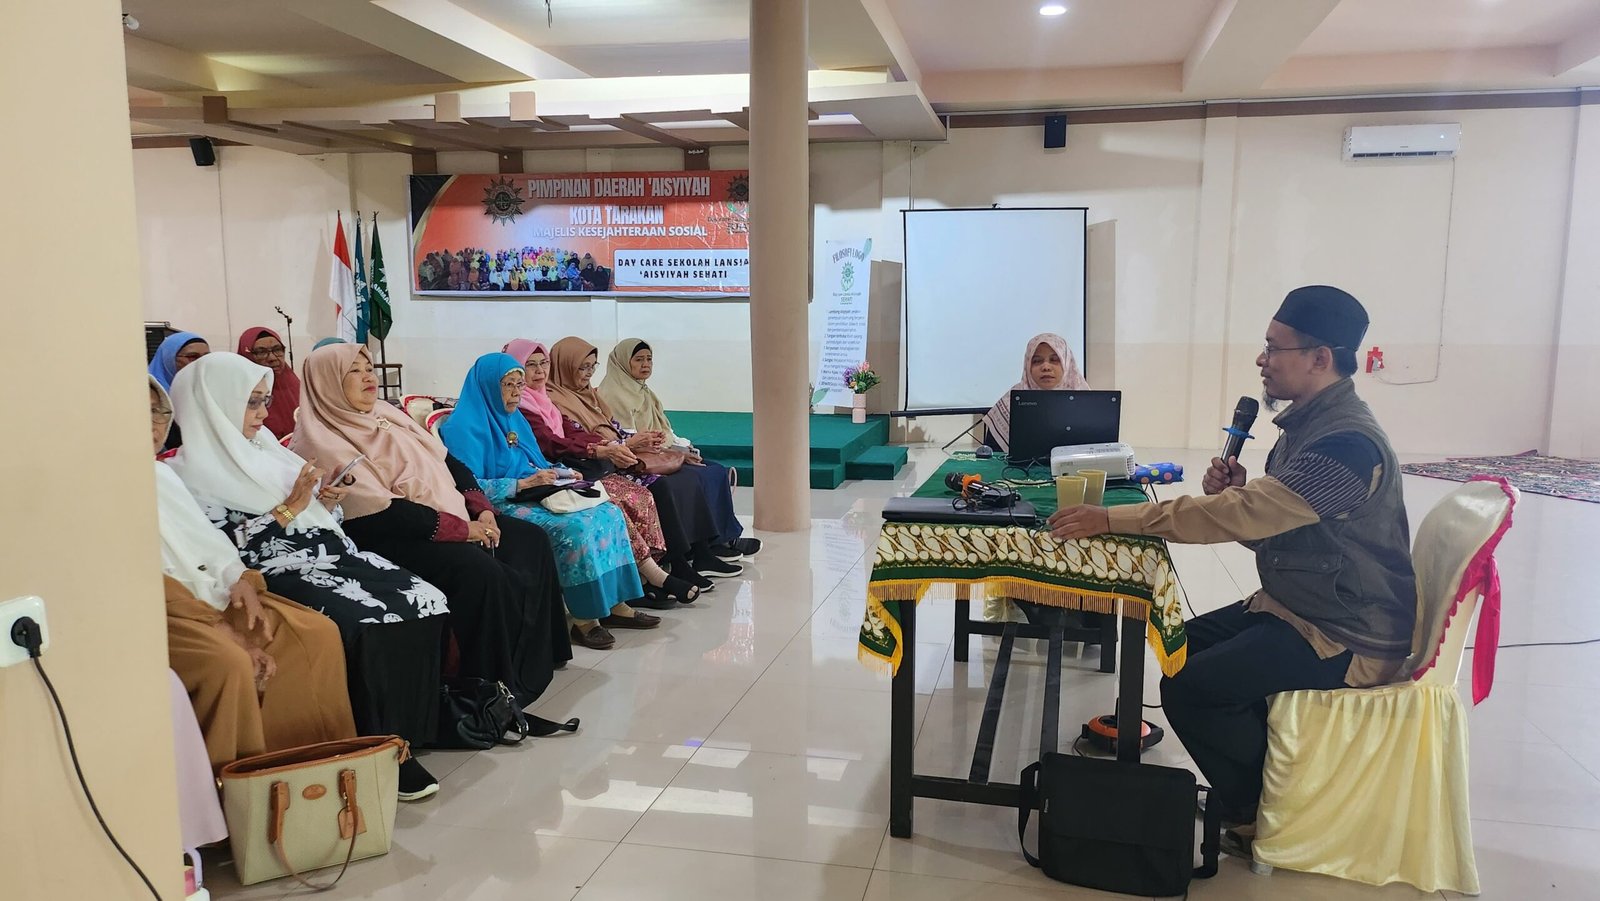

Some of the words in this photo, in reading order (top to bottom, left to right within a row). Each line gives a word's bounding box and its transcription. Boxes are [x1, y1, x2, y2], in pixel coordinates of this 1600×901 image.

[528, 178, 591, 198] PIMPINAN
[594, 177, 645, 197] DAERAH
[648, 176, 711, 197] 'AISYIYAH
[569, 205, 602, 225] KOTA
[605, 204, 664, 225] TARAKAN
[533, 226, 576, 240] MAJELIS
[578, 226, 666, 239] KESEJAHTERAAN
[668, 226, 708, 237] SOSIAL
[618, 258, 637, 267] DAY
[640, 258, 664, 267] CARE
[667, 258, 711, 267] SEKOLAH
[714, 258, 749, 267] LANSIA
[692, 270, 728, 279] SEHATI
